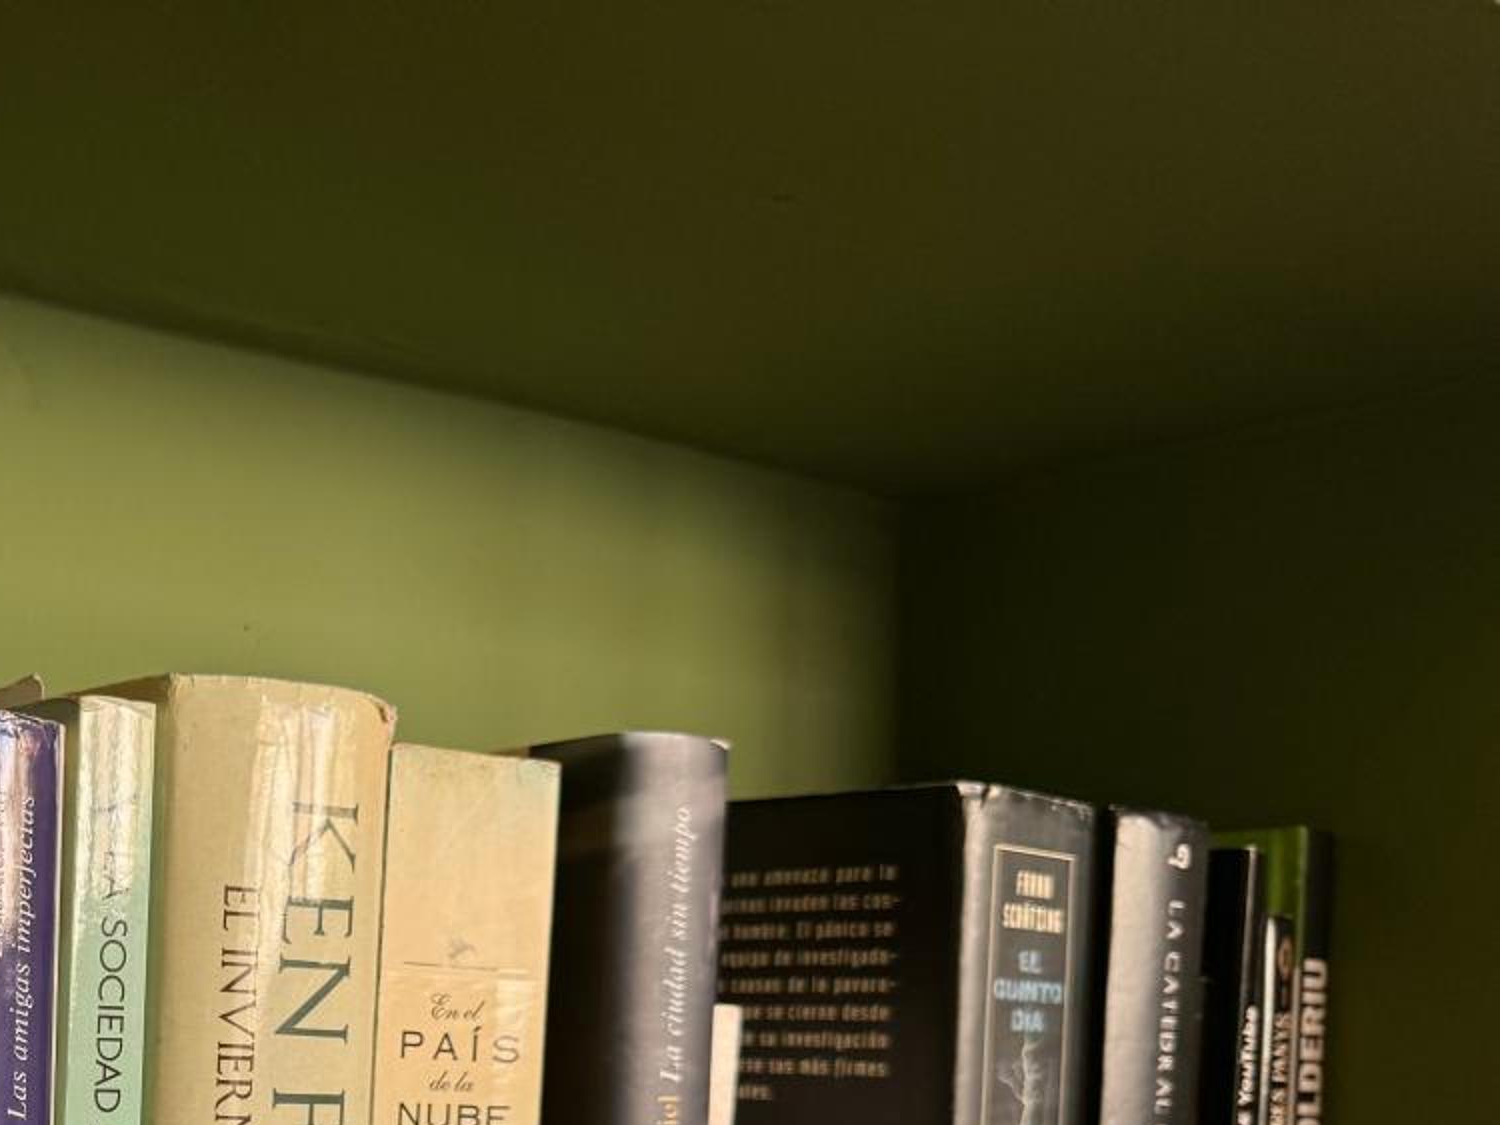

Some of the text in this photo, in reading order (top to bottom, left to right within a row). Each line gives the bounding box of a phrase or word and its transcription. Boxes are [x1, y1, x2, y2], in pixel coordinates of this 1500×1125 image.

[222, 884, 259, 930] EL
[274, 802, 360, 1045] KEN
[1166, 900, 1185, 938] LA
[7, 797, 37, 1121] Las amigas imperfectas
[659, 806, 697, 1082] La ciudad sin tiempo
[1018, 951, 1042, 973] EL
[431, 993, 484, 1021] En el
[993, 978, 1062, 1004] QUINTO
[94, 916, 128, 1114] SOCIEDAD
[1155, 952, 1182, 1115] CATEDRAL
[400, 1026, 520, 1063] PAÍS
[1237, 1005, 1258, 1105] YouTube
[429, 1071, 474, 1092] de la
